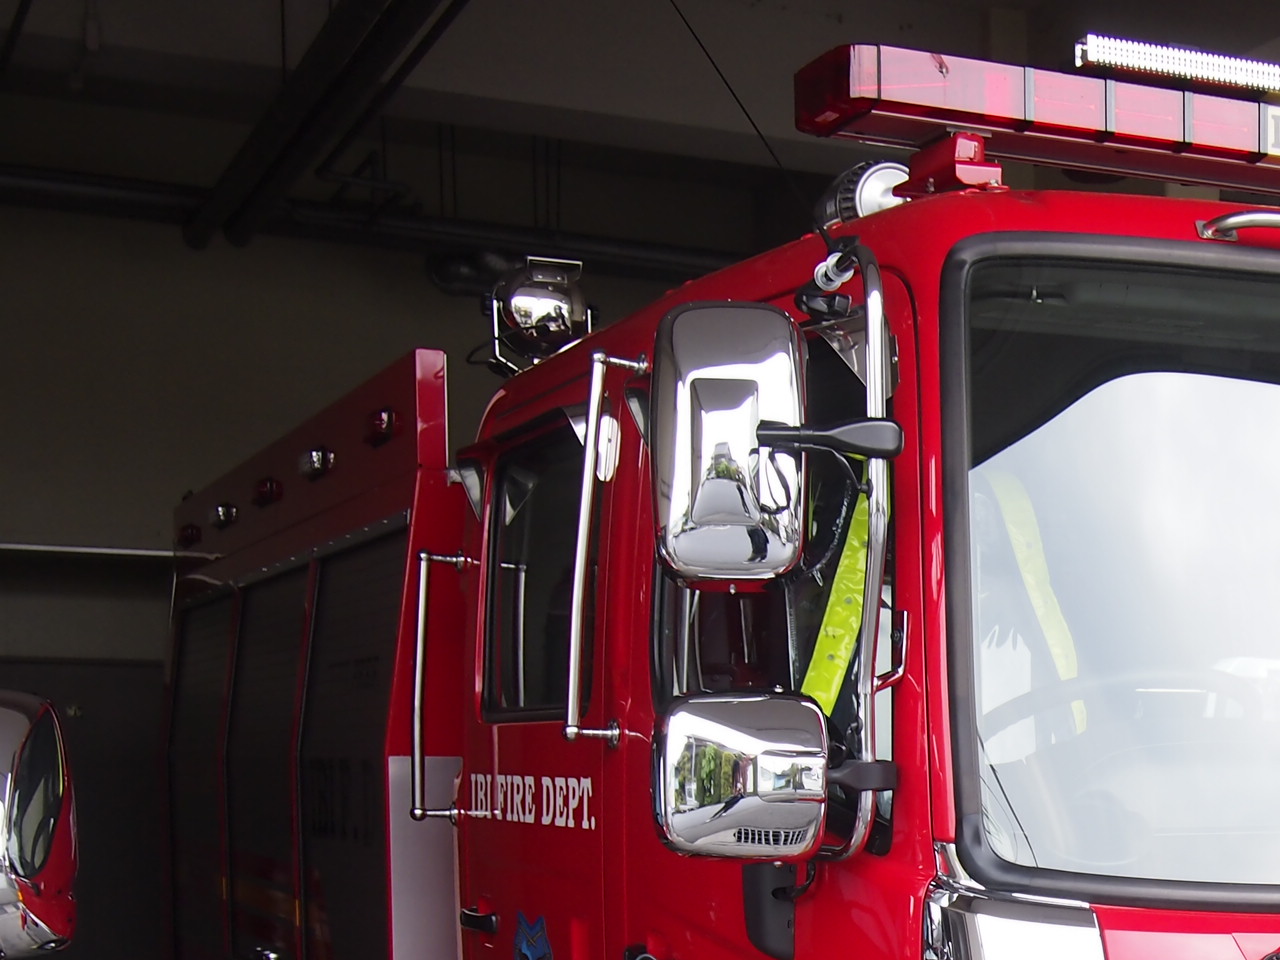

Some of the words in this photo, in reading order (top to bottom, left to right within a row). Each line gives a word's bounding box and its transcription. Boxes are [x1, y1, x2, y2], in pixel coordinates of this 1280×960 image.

[470, 772, 492, 819] IBI
[496, 774, 536, 824] FIRE
[541, 776, 596, 831] DEPT.
